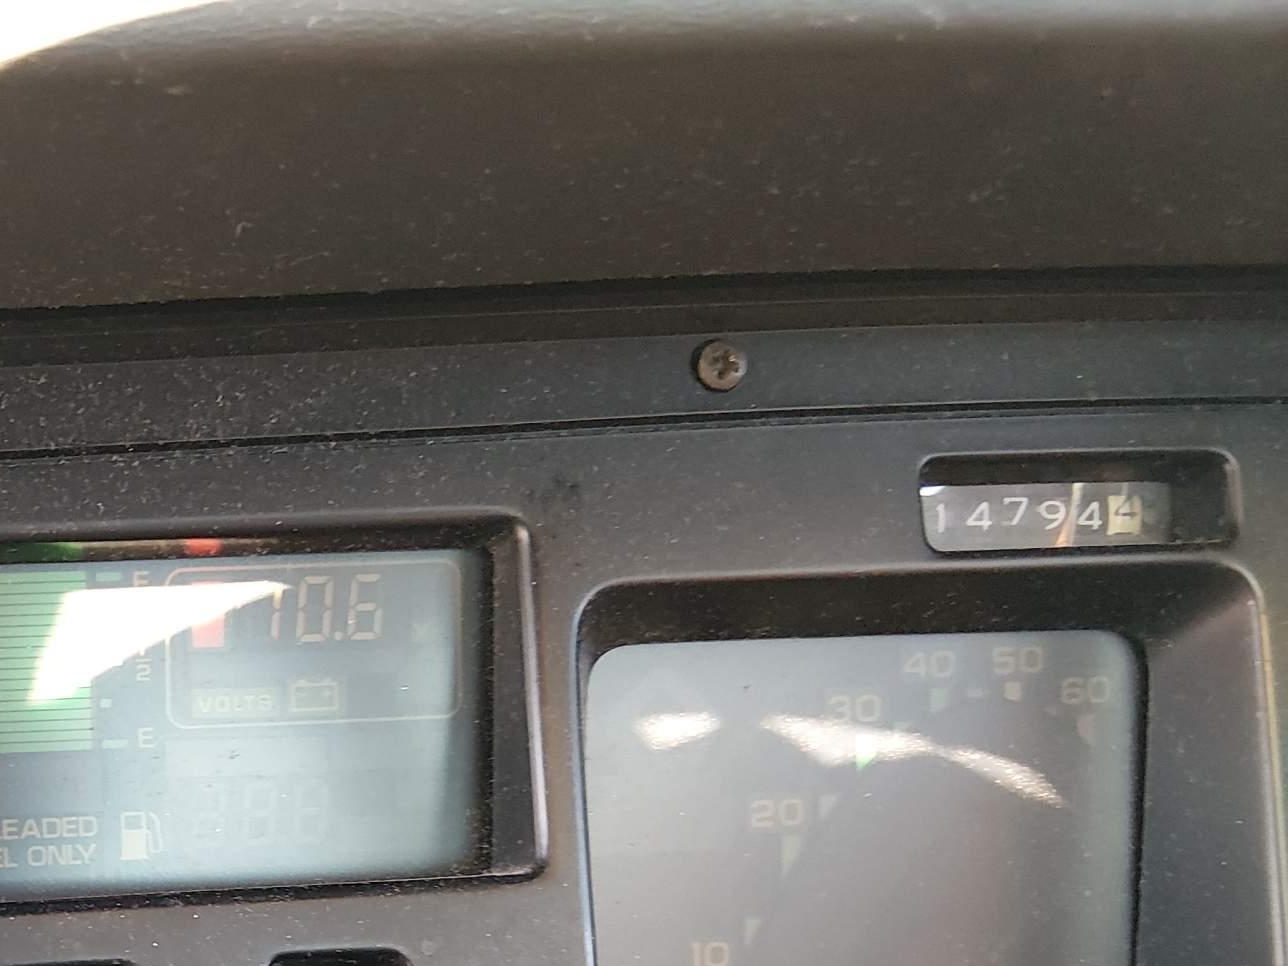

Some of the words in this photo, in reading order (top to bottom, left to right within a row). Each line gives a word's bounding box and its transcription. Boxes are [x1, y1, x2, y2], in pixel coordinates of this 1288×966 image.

[903, 649, 955, 680] 40
[992, 646, 1043, 677] 50
[197, 692, 273, 714] VOLTS
[1059, 676, 1110, 707] 60
[827, 694, 882, 724] 30
[137, 727, 155, 749] E
[750, 800, 805, 831] 20
[28, 842, 98, 867] ONLY
